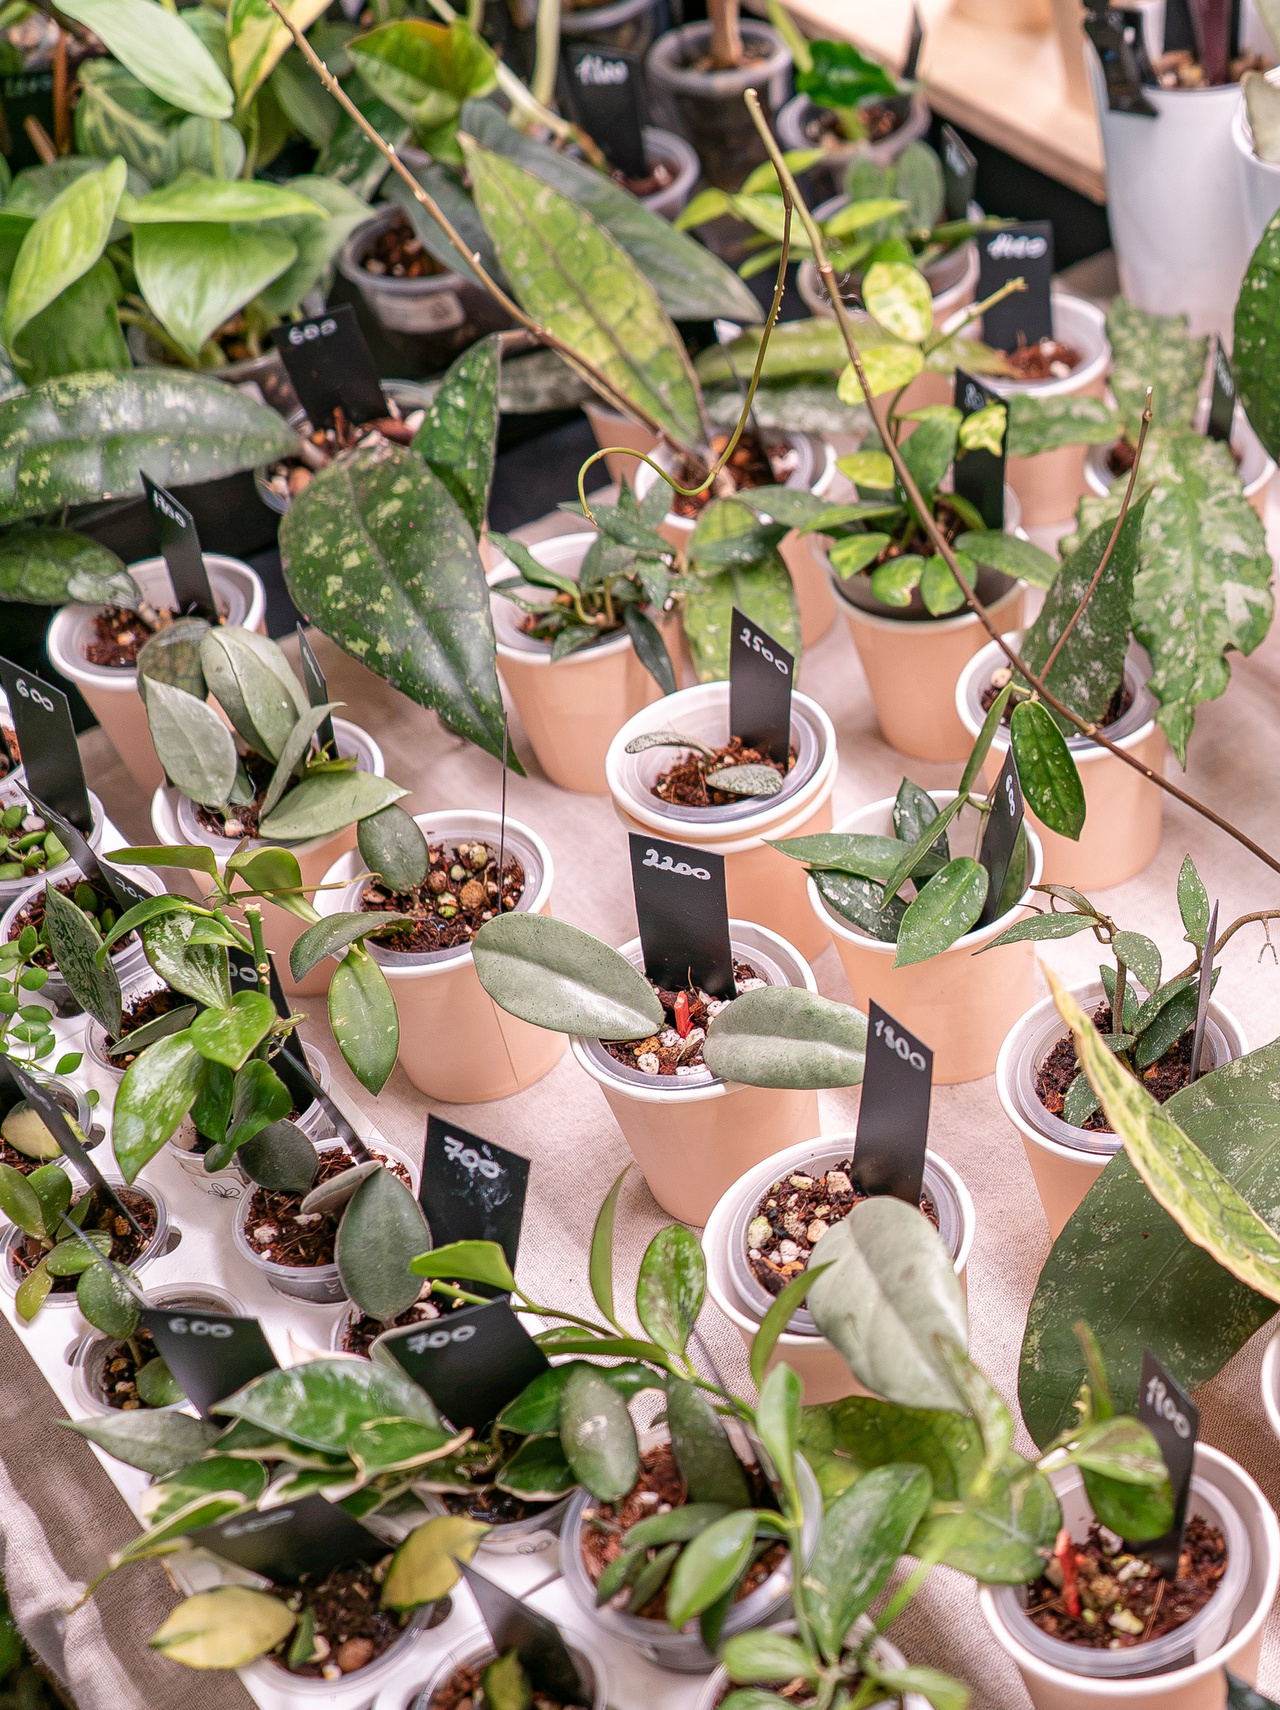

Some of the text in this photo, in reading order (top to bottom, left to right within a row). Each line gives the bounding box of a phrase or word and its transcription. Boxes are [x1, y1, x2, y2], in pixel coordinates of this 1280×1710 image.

[739, 627, 789, 675] 2500
[16, 678, 55, 712] 600
[642, 848, 711, 880] 2200
[443, 1135, 500, 1180] 700
[168, 1317, 235, 1338] 600
